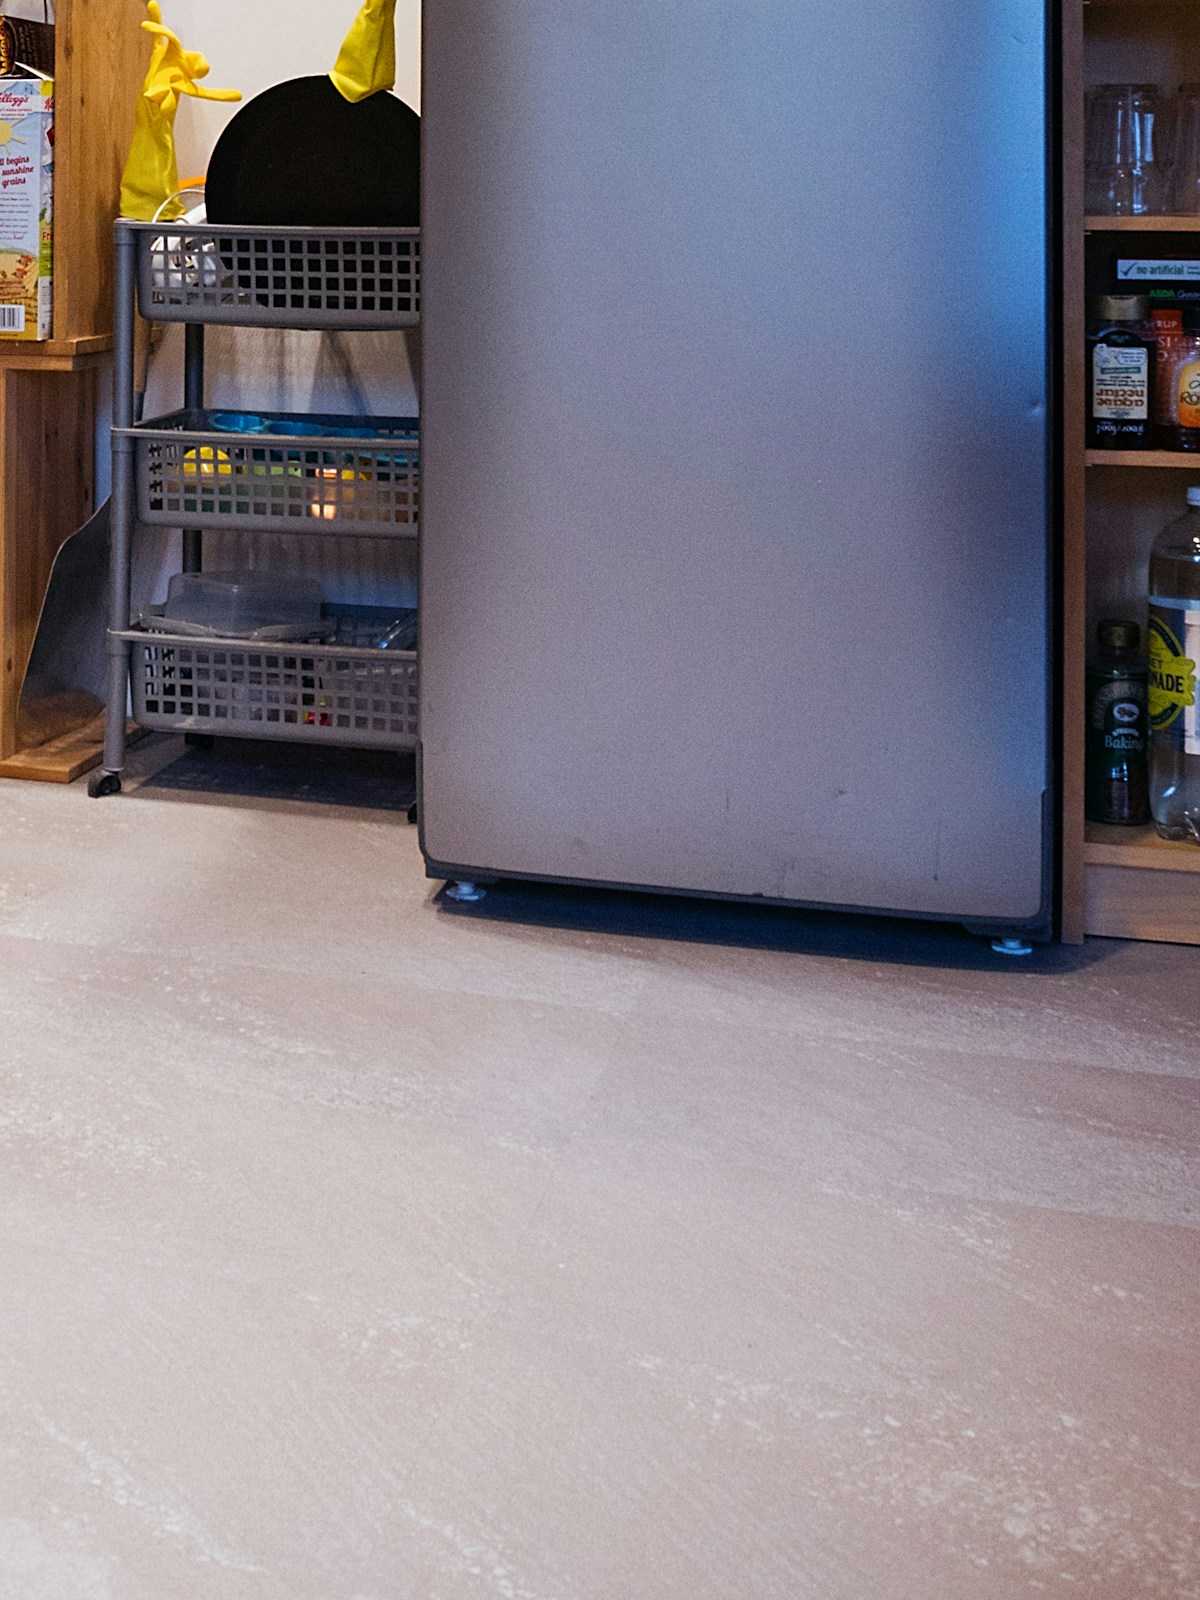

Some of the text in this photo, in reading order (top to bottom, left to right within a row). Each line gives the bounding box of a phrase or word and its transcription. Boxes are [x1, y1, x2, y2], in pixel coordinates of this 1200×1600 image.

[6, 156, 30, 167] begins
[2, 166, 34, 177] sunshine
[2, 177, 26, 189] grains
[1149, 265, 1184, 275] artificial
[1149, 289, 1175, 298] ASDA
